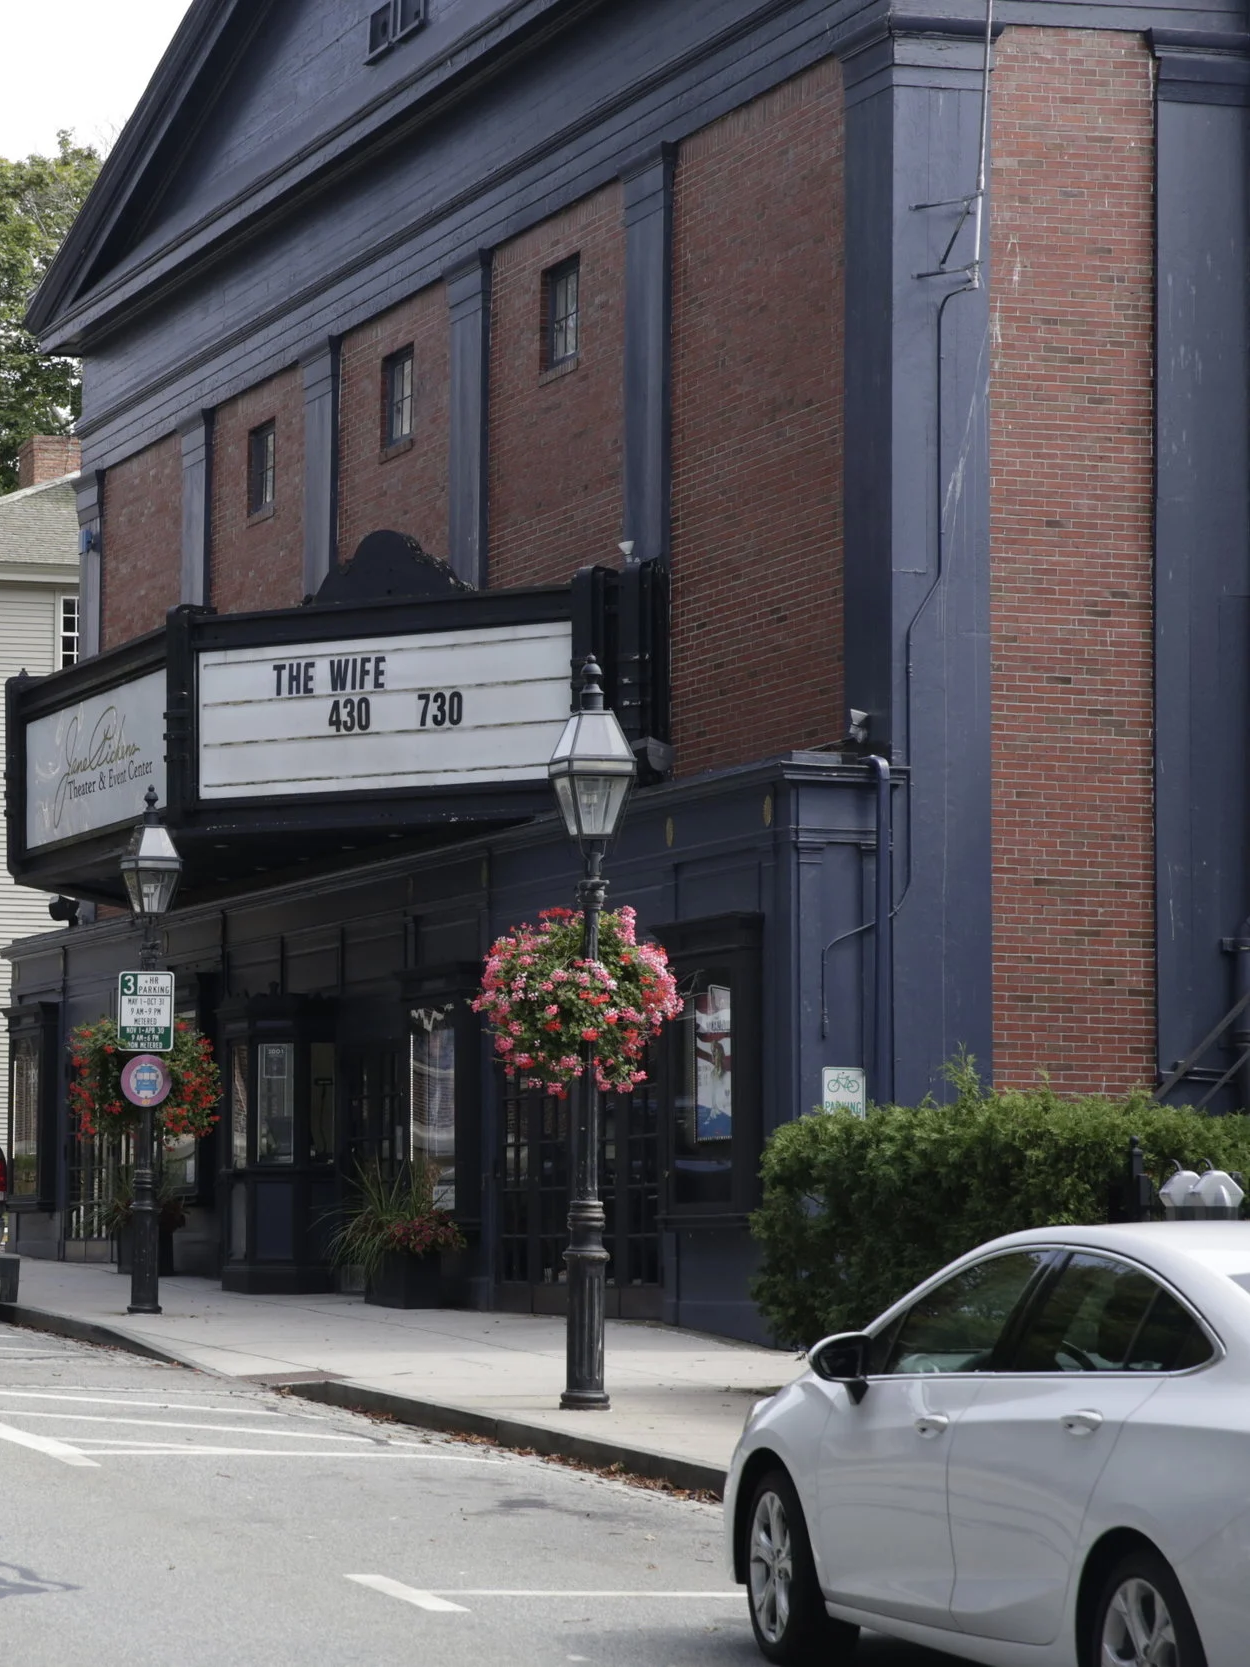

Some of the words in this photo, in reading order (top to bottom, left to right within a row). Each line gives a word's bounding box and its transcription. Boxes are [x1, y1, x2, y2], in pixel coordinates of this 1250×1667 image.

[272, 661, 315, 696] THE
[329, 656, 386, 692] WIFE
[328, 696, 371, 732] 430
[417, 691, 463, 727] 730
[67, 778, 97, 800] Theater
[98, 771, 106, 791] &
[108, 768, 127, 788] Event
[128, 760, 153, 781] Center
[123, 975, 135, 994] 3
[149, 976, 159, 984] HR
[138, 985, 170, 994] PARKING
[127, 997, 137, 1005] MAY
[159, 997, 165, 1005] 31
[153, 1007, 162, 1015] PM
[133, 1017, 158, 1026] METERED
[139, 1041, 163, 1049] METERED
